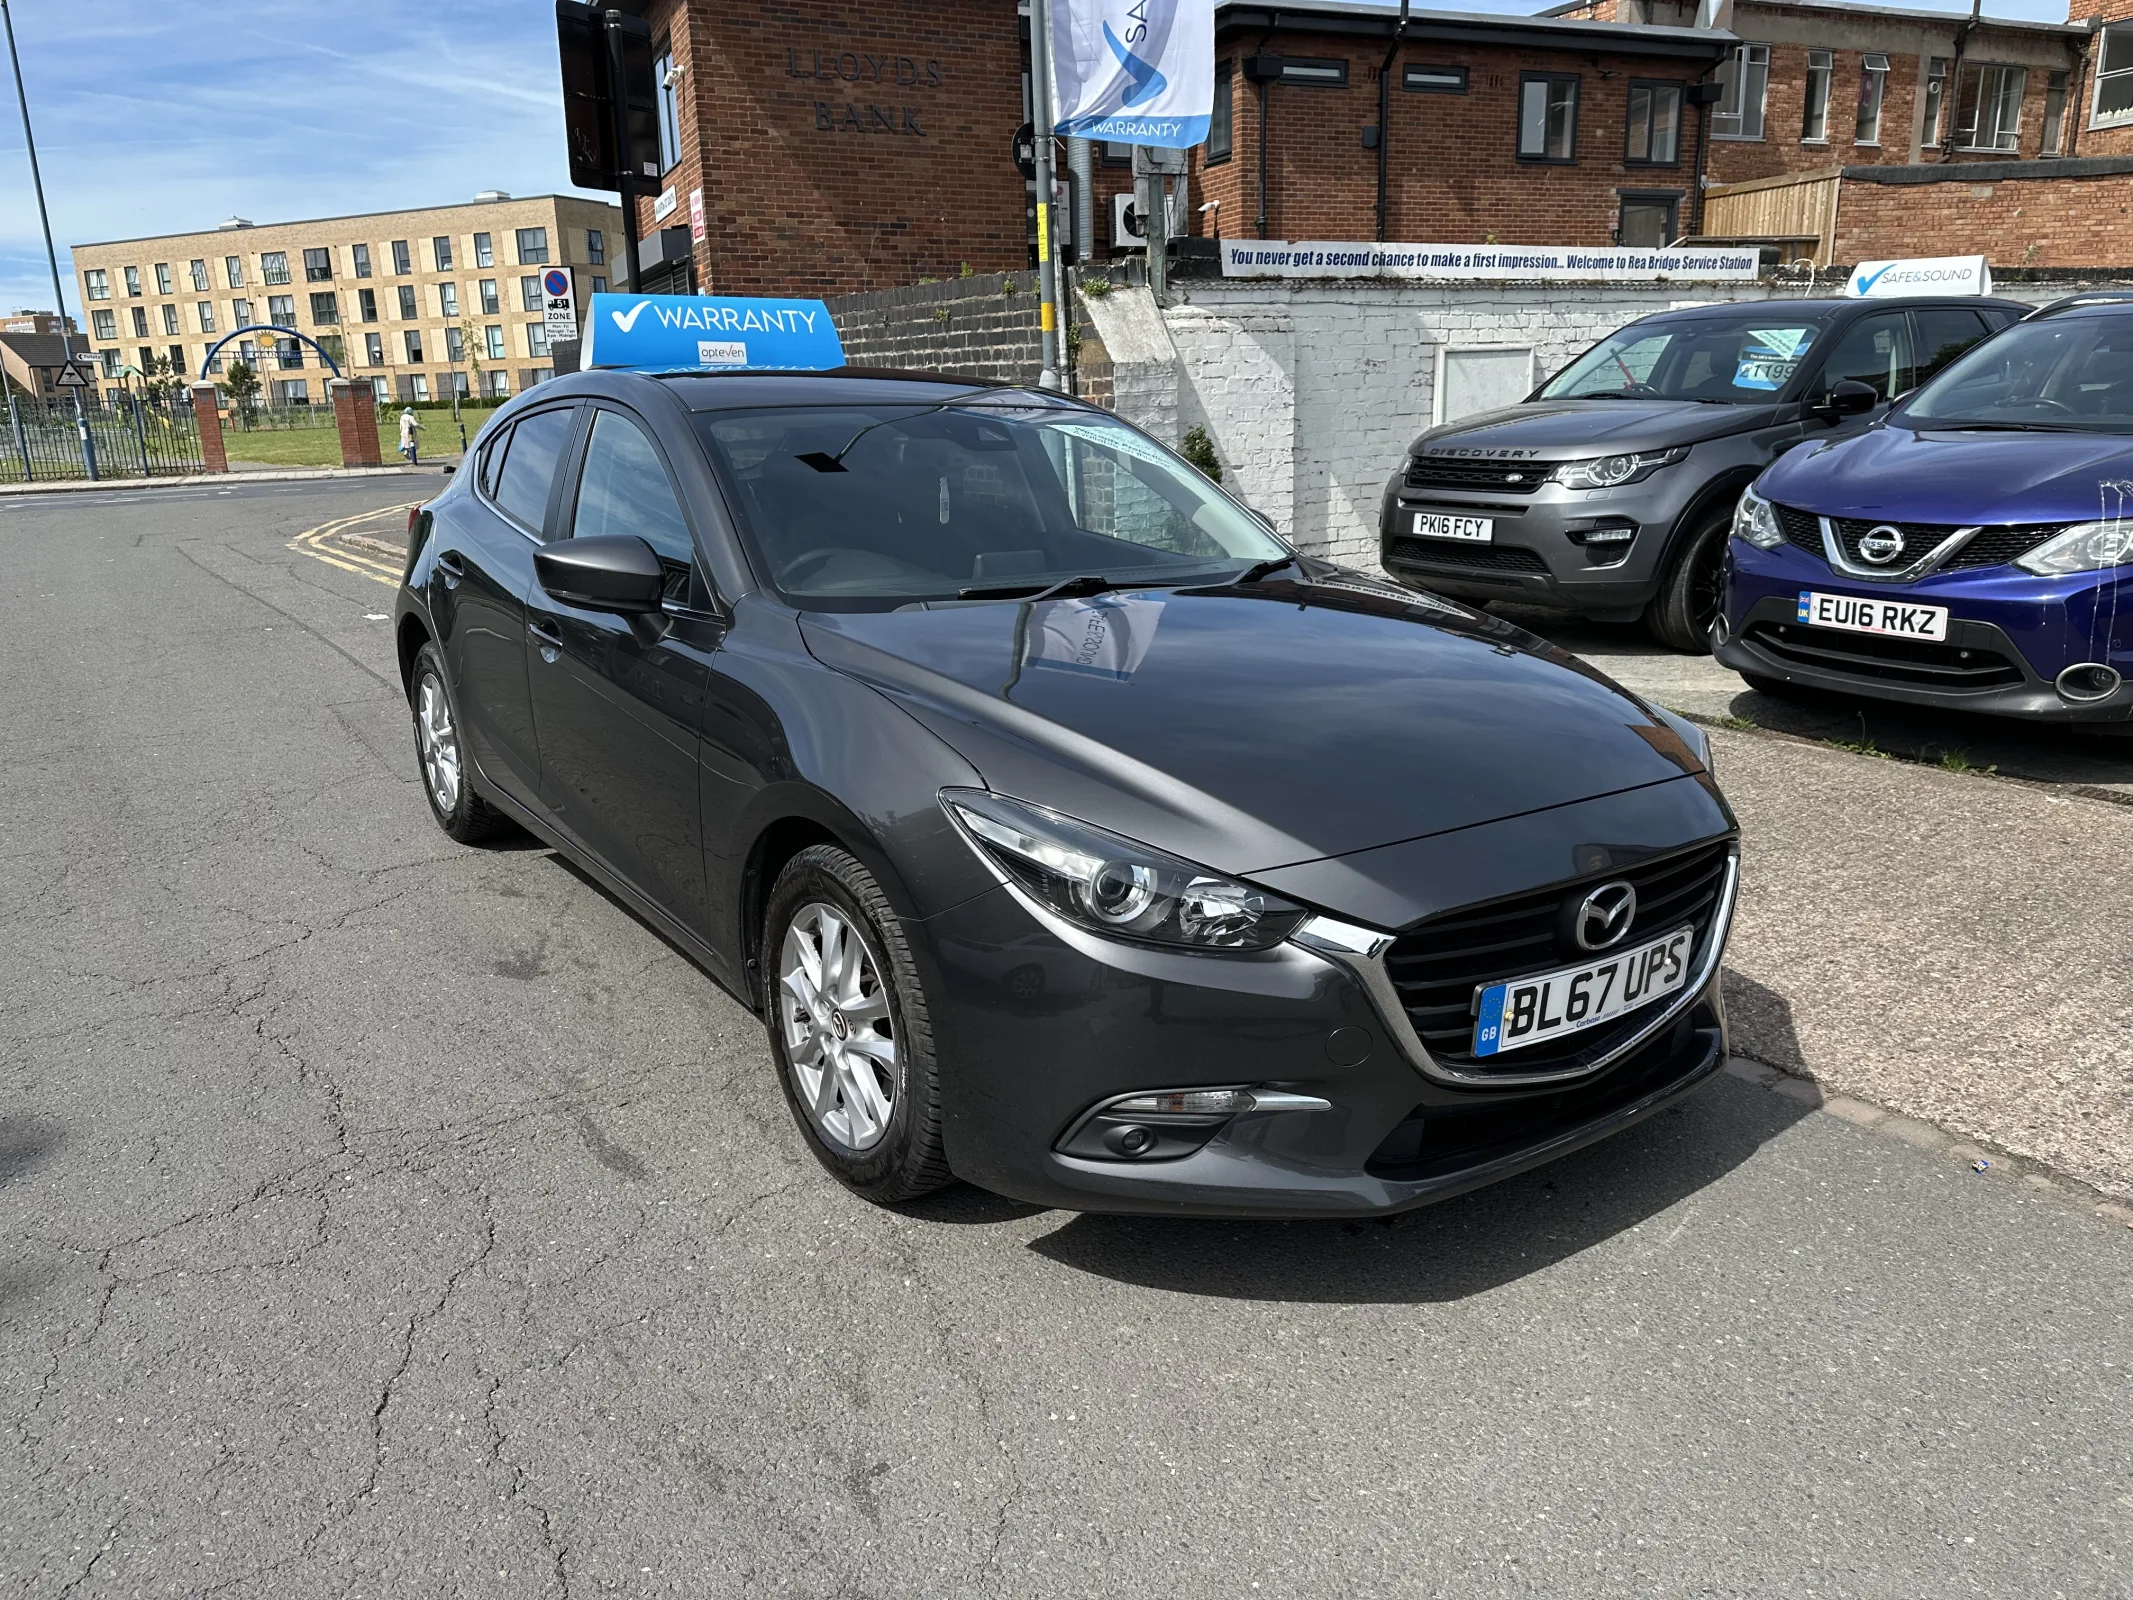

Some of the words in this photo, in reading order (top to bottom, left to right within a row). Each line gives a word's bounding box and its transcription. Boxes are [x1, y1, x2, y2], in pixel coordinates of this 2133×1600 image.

[787, 47, 942, 88] LLOYDS
[814, 100, 928, 137] BANK
[1092, 121, 1181, 137] WARRANTY
[1231, 249, 1252, 265] You
[1255, 251, 1291, 266] never
[1293, 251, 1315, 267] get
[1316, 253, 1323, 266] a
[1326, 251, 1369, 266] second
[1372, 252, 1414, 267] chance
[1416, 253, 1428, 267] to
[1431, 253, 1461, 267] make
[1464, 255, 1470, 267] a
[1473, 253, 1496, 268] first
[1498, 253, 1564, 271] impression...
[1567, 255, 1614, 269] Welcome
[1616, 255, 1626, 269] to
[1628, 255, 1646, 270] Rea
[1648, 255, 1680, 271] Bridge
[1682, 256, 1717, 270] Service
[1719, 256, 1752, 270] Station
[1881, 268, 1972, 284] SAFE&SOUND
[548, 312, 571, 320] ZONE
[653, 305, 816, 334] WARRANTY
[701, 344, 745, 359] opteven
[1429, 448, 1540, 458] DISCOVERY
[1420, 515, 1450, 534] PK16
[1453, 518, 1484, 537] FCY
[1861, 540, 1897, 549] NISSAN
[1798, 608, 1809, 617] UK
[1818, 598, 1874, 626] EU16
[1881, 606, 1936, 635] RKZ
[1507, 962, 1619, 1039] BL67
[1623, 935, 1686, 1003] UPS
[1576, 1016, 1601, 1028] Carbase
[1481, 1026, 1497, 1041] GB
